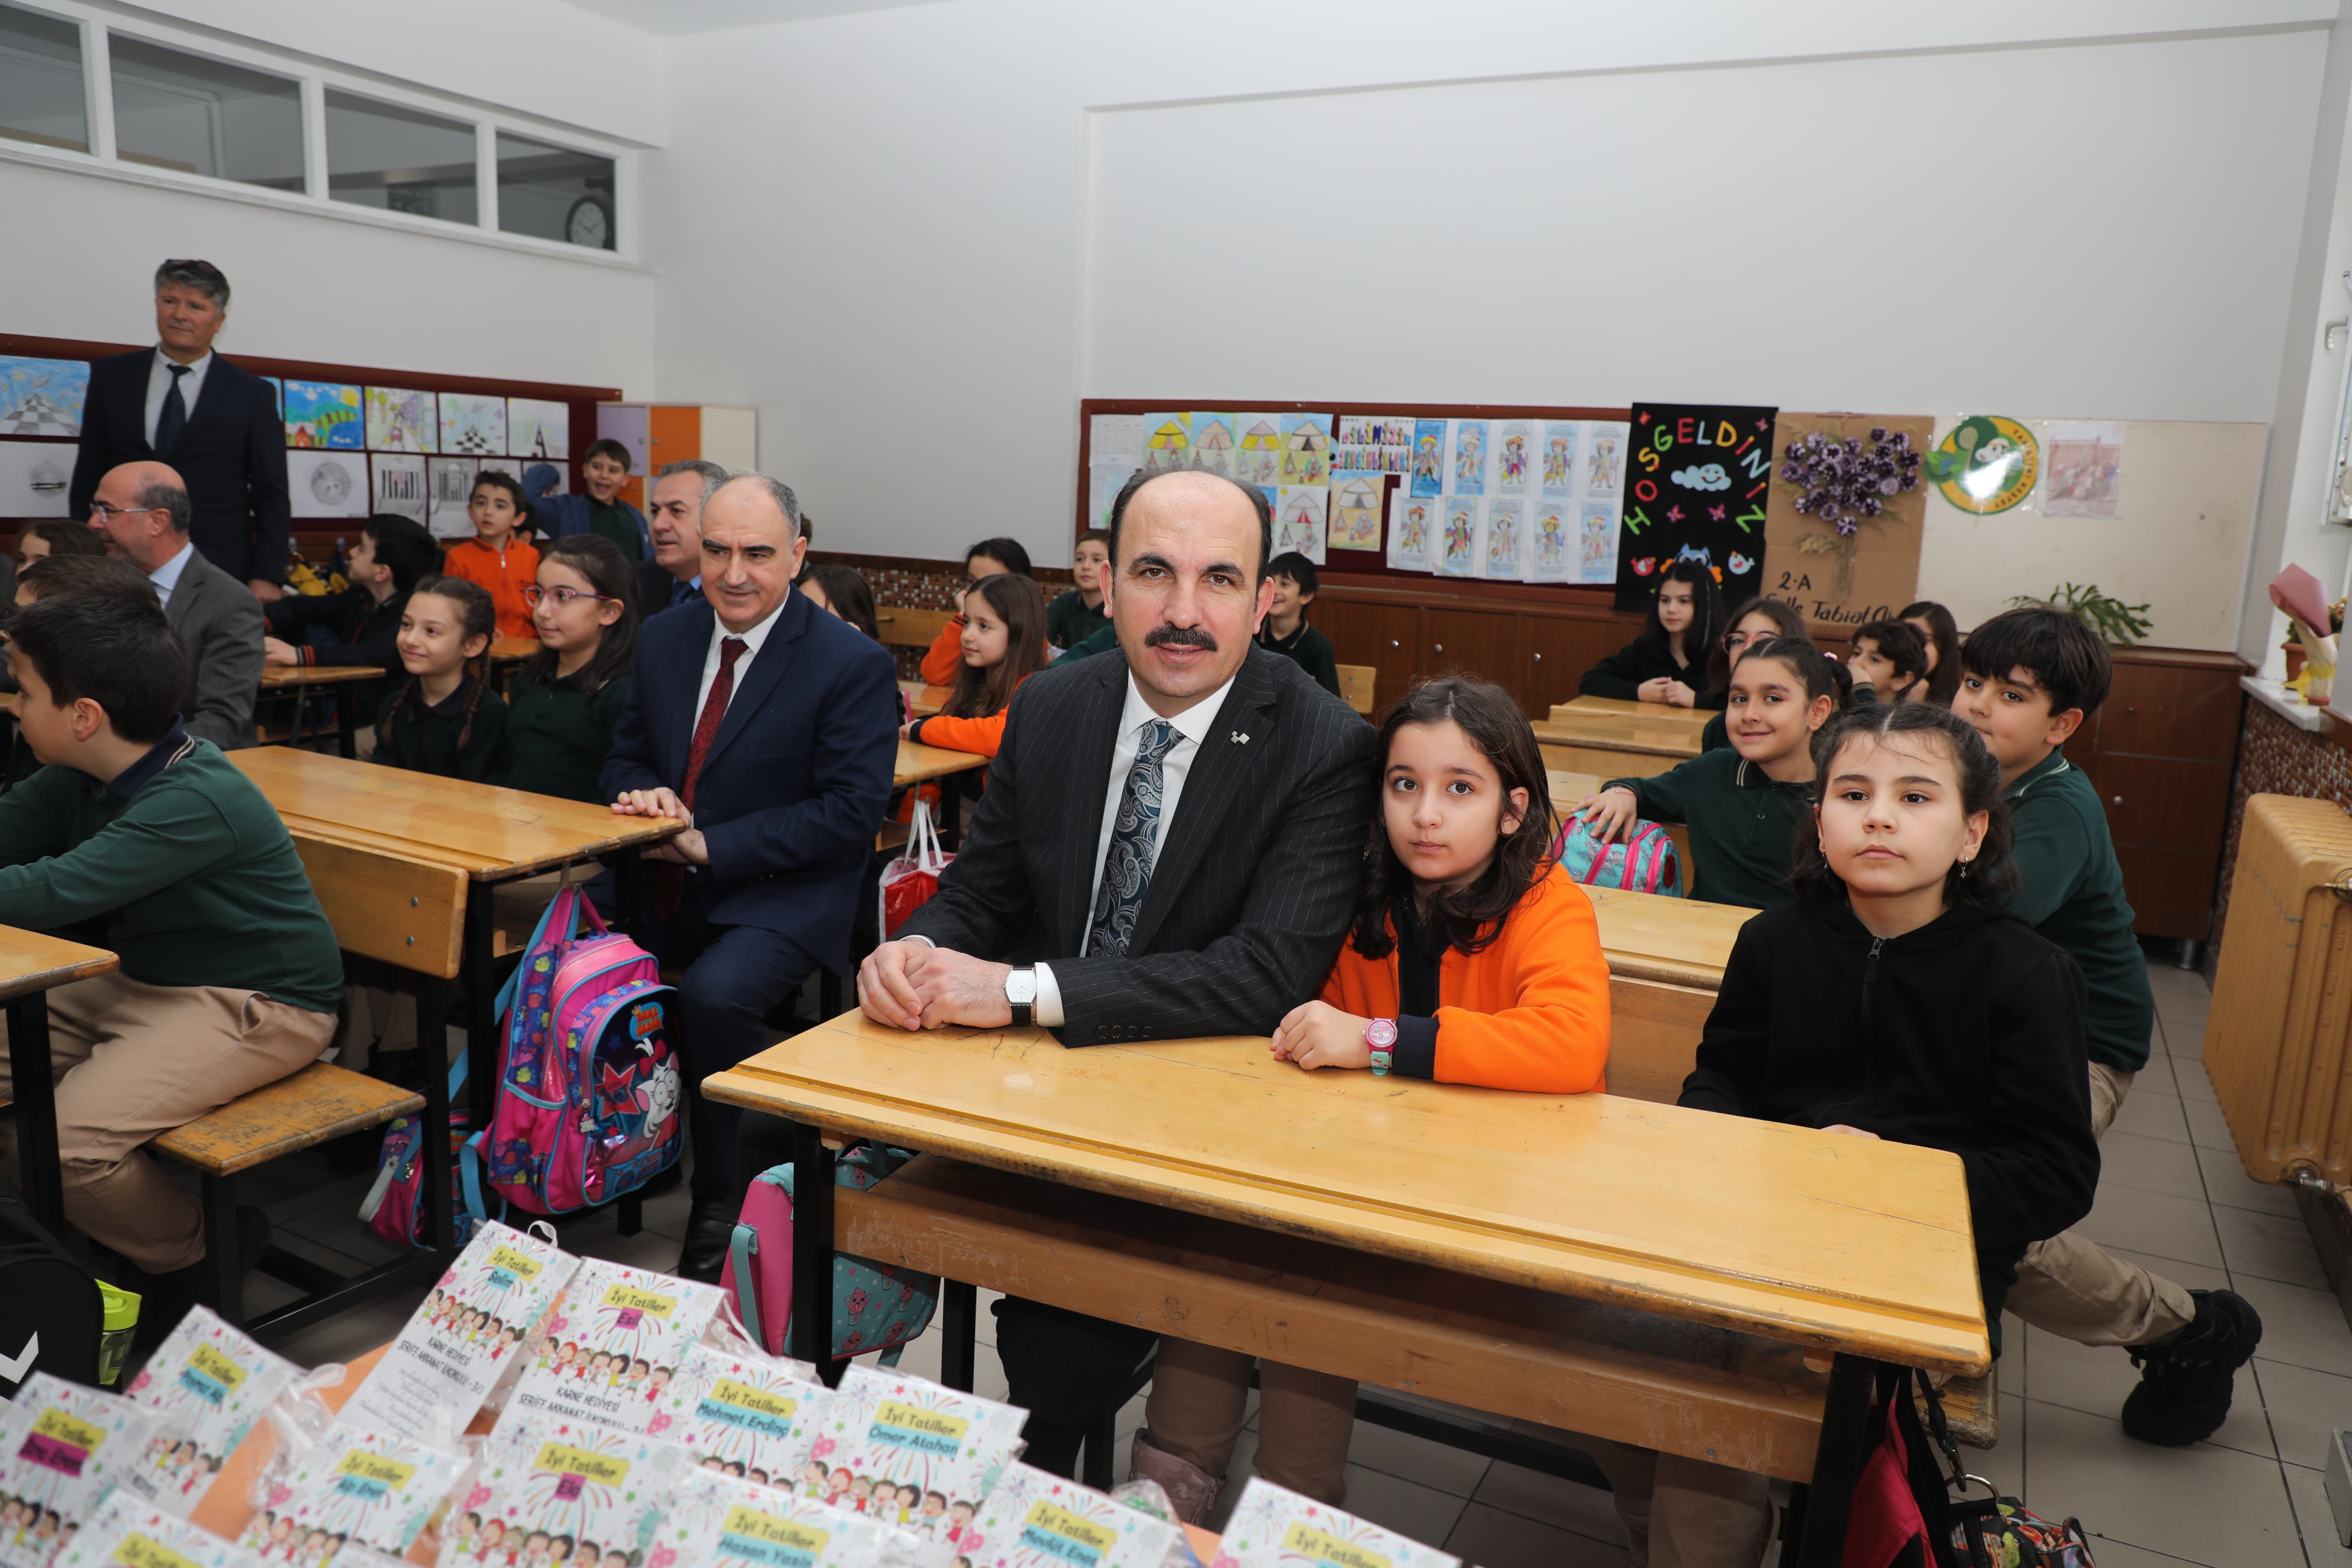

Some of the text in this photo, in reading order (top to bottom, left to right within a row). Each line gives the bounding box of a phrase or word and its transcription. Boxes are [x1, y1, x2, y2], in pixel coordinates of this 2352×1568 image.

[488, 1271, 514, 1288] Selim
[611, 1288, 667, 1313] İyi Tatiller
[548, 1402, 585, 1419] AKKANAT
[556, 1387, 621, 1413] KARNE HEDİYESİ
[720, 1384, 785, 1416] İyi Tatiller
[696, 1404, 789, 1437] Mehmet Erdinç
[885, 1406, 956, 1436] İyi Tatiller
[869, 1424, 958, 1455] Ömer Atahan
[569, 1456, 616, 1478] Tatiller
[761, 1522, 816, 1548] Tatiller
[1058, 1518, 1104, 1547] Tatiller
